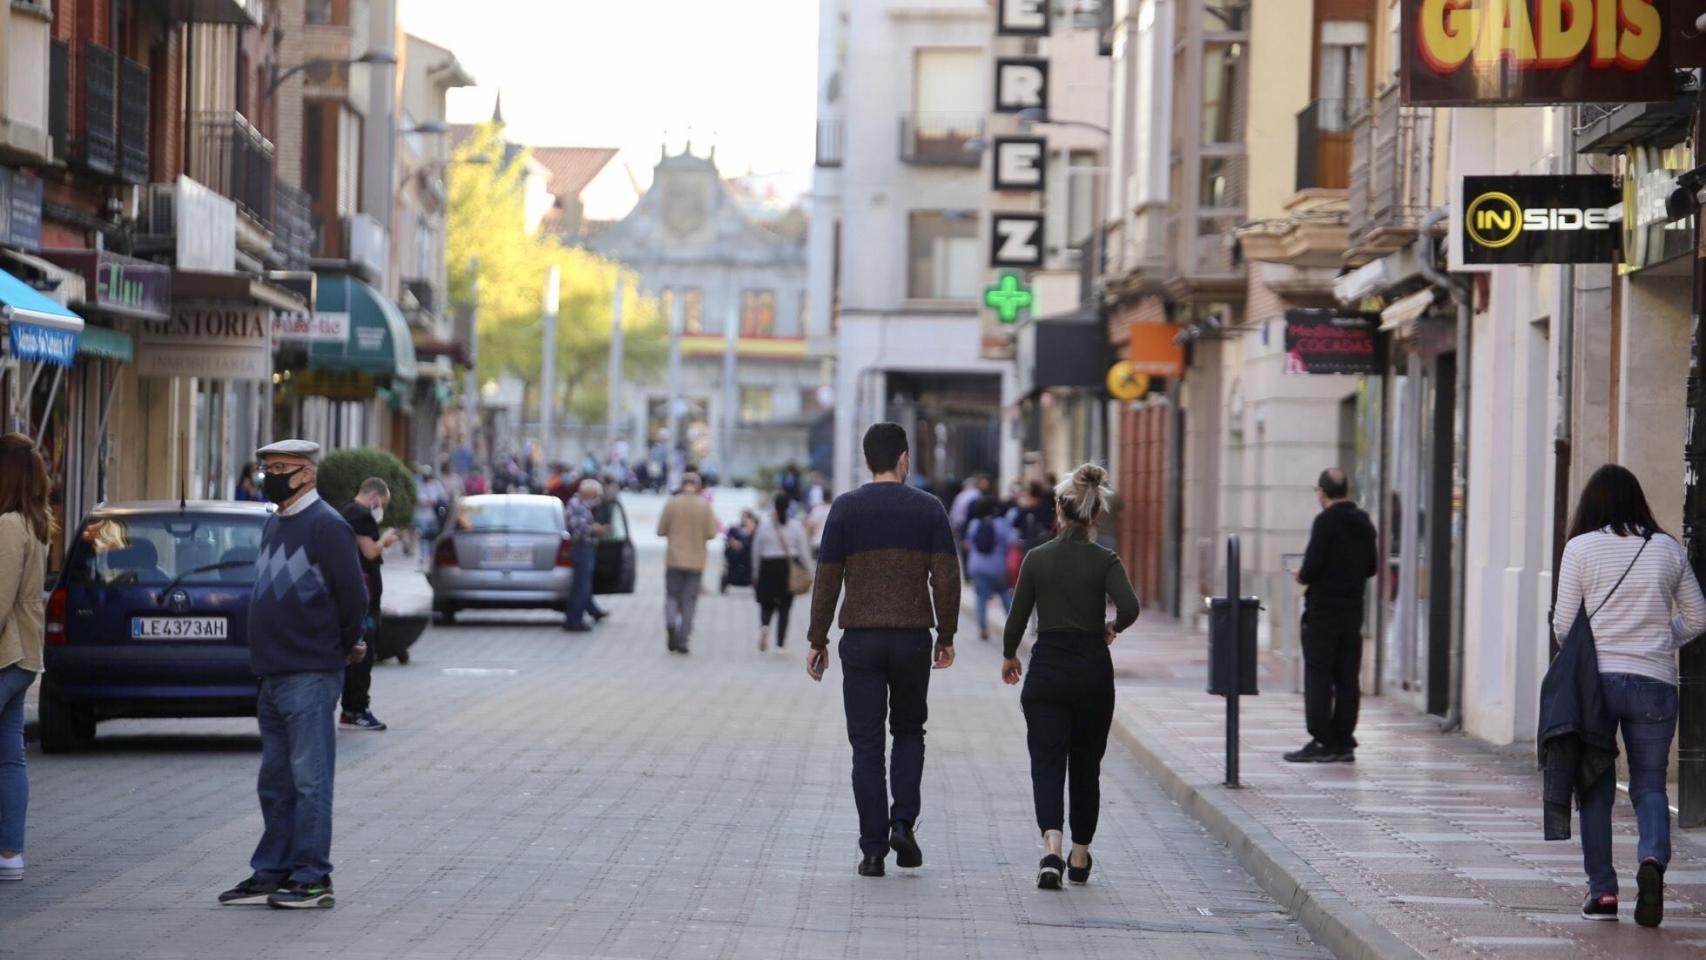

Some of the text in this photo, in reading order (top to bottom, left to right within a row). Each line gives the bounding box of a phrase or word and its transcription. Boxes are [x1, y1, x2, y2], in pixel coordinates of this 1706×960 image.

[1417, 0, 1662, 75] GADIS
[1297, 338, 1374, 353] COCADAS
[141, 620, 224, 636] LE4373AH
